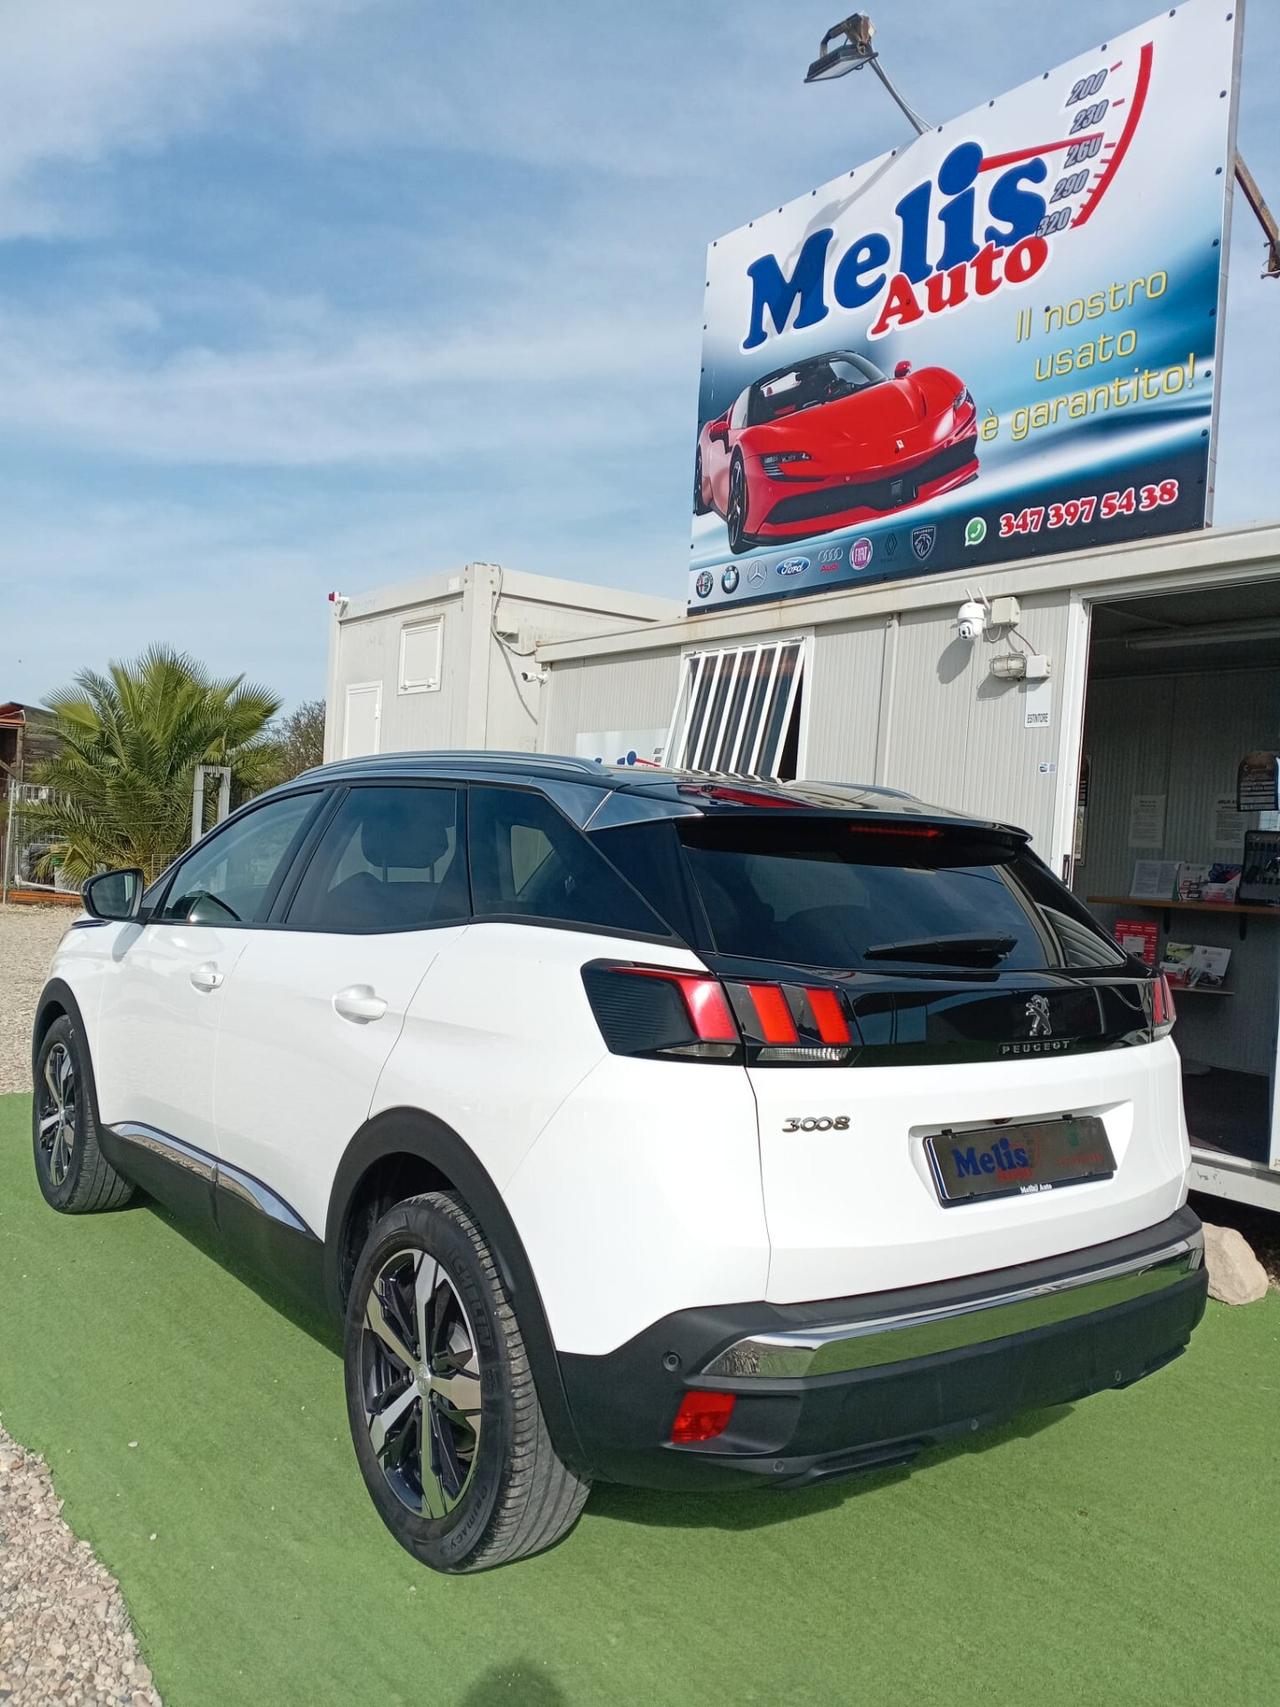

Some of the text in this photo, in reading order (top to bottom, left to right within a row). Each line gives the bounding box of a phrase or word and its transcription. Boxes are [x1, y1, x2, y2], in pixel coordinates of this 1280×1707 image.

[1065, 69, 1108, 107] 200
[1069, 99, 1109, 135] 230
[1063, 134, 1103, 169] 260
[1049, 169, 1090, 204] 290
[1035, 207, 1071, 239] 320
[743, 141, 1048, 349] Melis
[871, 235, 1048, 335] Auto
[1016, 271, 1167, 342] Il nostro
[1034, 329, 1137, 382] usato
[981, 352, 1196, 441] è garantito!
[1000, 479, 1179, 537] 347 397 54 38
[781, 560, 804, 575] Ford
[1001, 1040, 1070, 1055] PEUGEOT
[782, 1116, 851, 1132] 3008
[952, 1138, 1030, 1178] Melis
